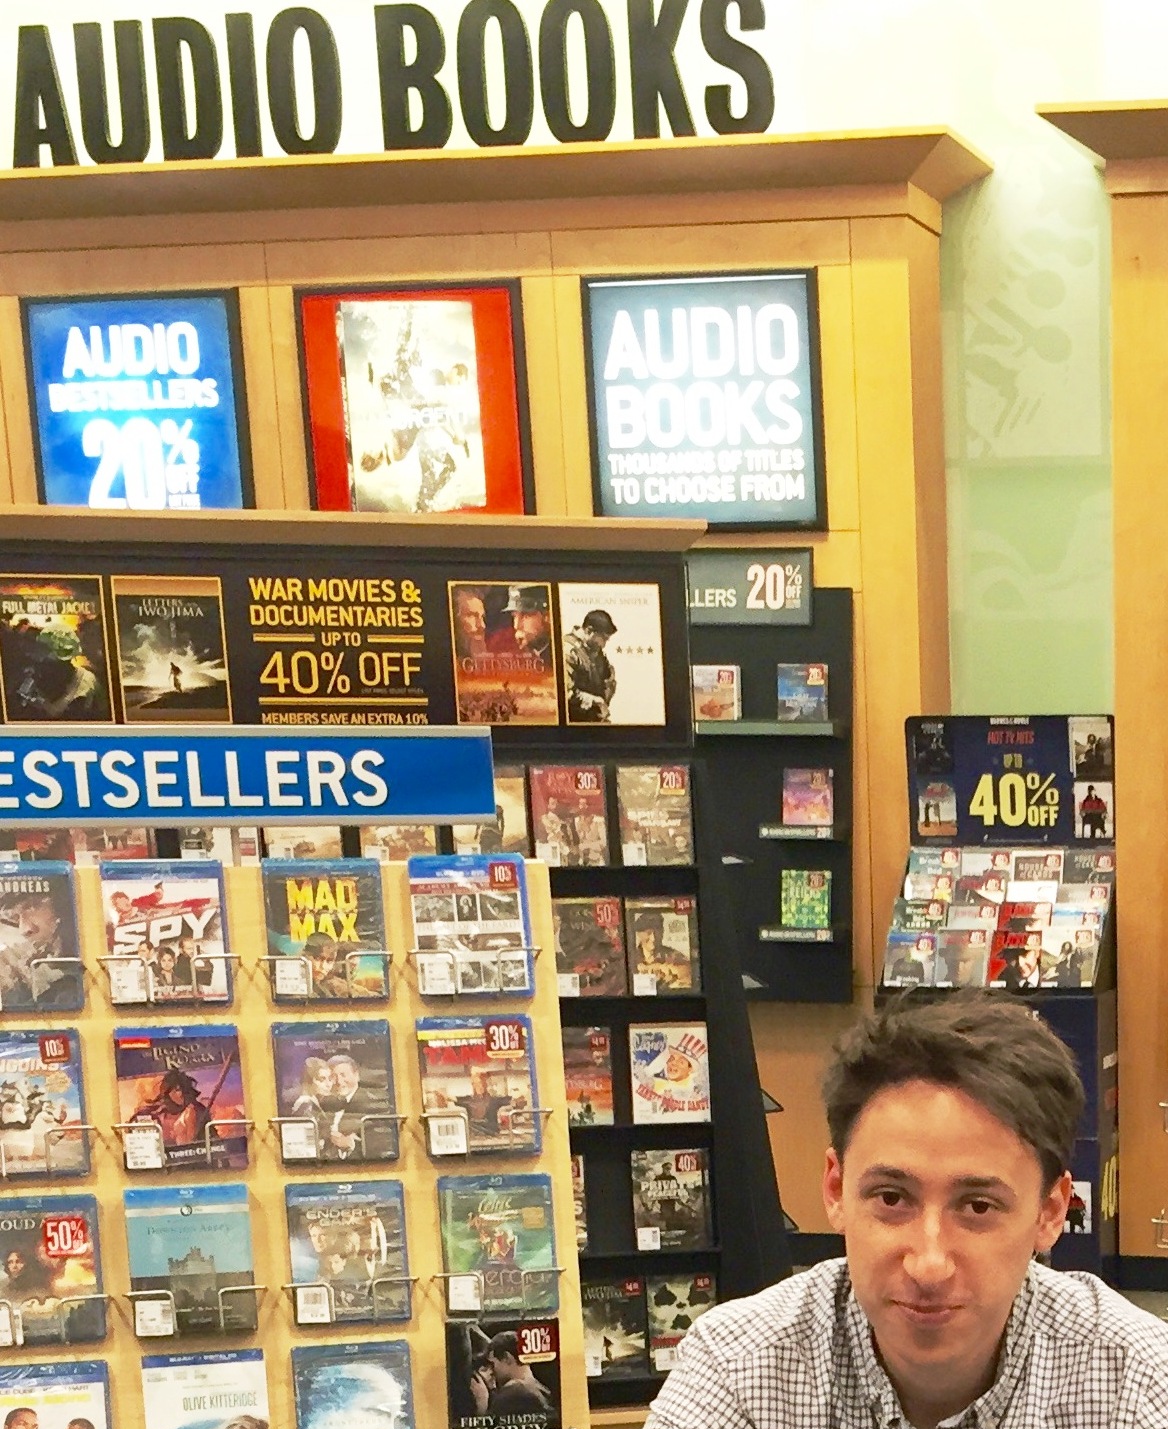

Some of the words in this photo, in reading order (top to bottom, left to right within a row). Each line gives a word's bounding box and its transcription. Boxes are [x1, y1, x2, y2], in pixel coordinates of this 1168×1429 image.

[13, 7, 342, 168] AUDIO
[374, 0, 776, 151] BOOKS
[63, 321, 200, 378] AUDIO
[603, 303, 800, 380] AUDIO
[48, 378, 220, 412] BESTSELLERS
[605, 379, 803, 448] BOOKS
[82, 417, 200, 510] 20%
[607, 452, 716, 475] THOUSANDS
[717, 450, 743, 473] OF
[743, 449, 805, 472] TITLES
[611, 478, 640, 504] TO
[644, 475, 736, 504] CHOOSE
[740, 473, 805, 502] FROM
[249, 577, 303, 601] WAR
[308, 578, 396, 602] MOVIES
[400, 580, 422, 603] &
[746, 564, 802, 610] 20%
[785, 585, 801, 599] OFF
[2, 601, 26, 614] FULL
[168, 606, 204, 618] JIMA
[249, 605, 424, 628] DOCUMENTARIES
[321, 632, 341, 646] UP
[343, 632, 362, 646] TO
[259, 651, 350, 694] 40%
[358, 651, 422, 686] OFF
[462, 657, 545, 673] GETTYSBURG
[262, 712, 319, 725] MEMBERS
[321, 713, 349, 725] SAVE
[350, 713, 366, 725] AN
[368, 713, 403, 725] EXTRA
[405, 713, 429, 725] 10%
[969, 772, 1059, 826] 40%
[1028, 805, 1059, 827] OFF
[286, 878, 358, 910] MAD
[113, 906, 219, 956] SPY
[289, 911, 361, 942] MAX
[44, 1038, 65, 1056] 10%
[489, 1024, 519, 1050] 30%
[46, 1221, 84, 1251] 50%
[520, 1328, 552, 1354] 30%
[182, 1396, 208, 1412] OLIVE
[209, 1391, 258, 1410] KITTERIDGE
[461, 1416, 495, 1428] FIFTY
[499, 1412, 548, 1425] SHADES
